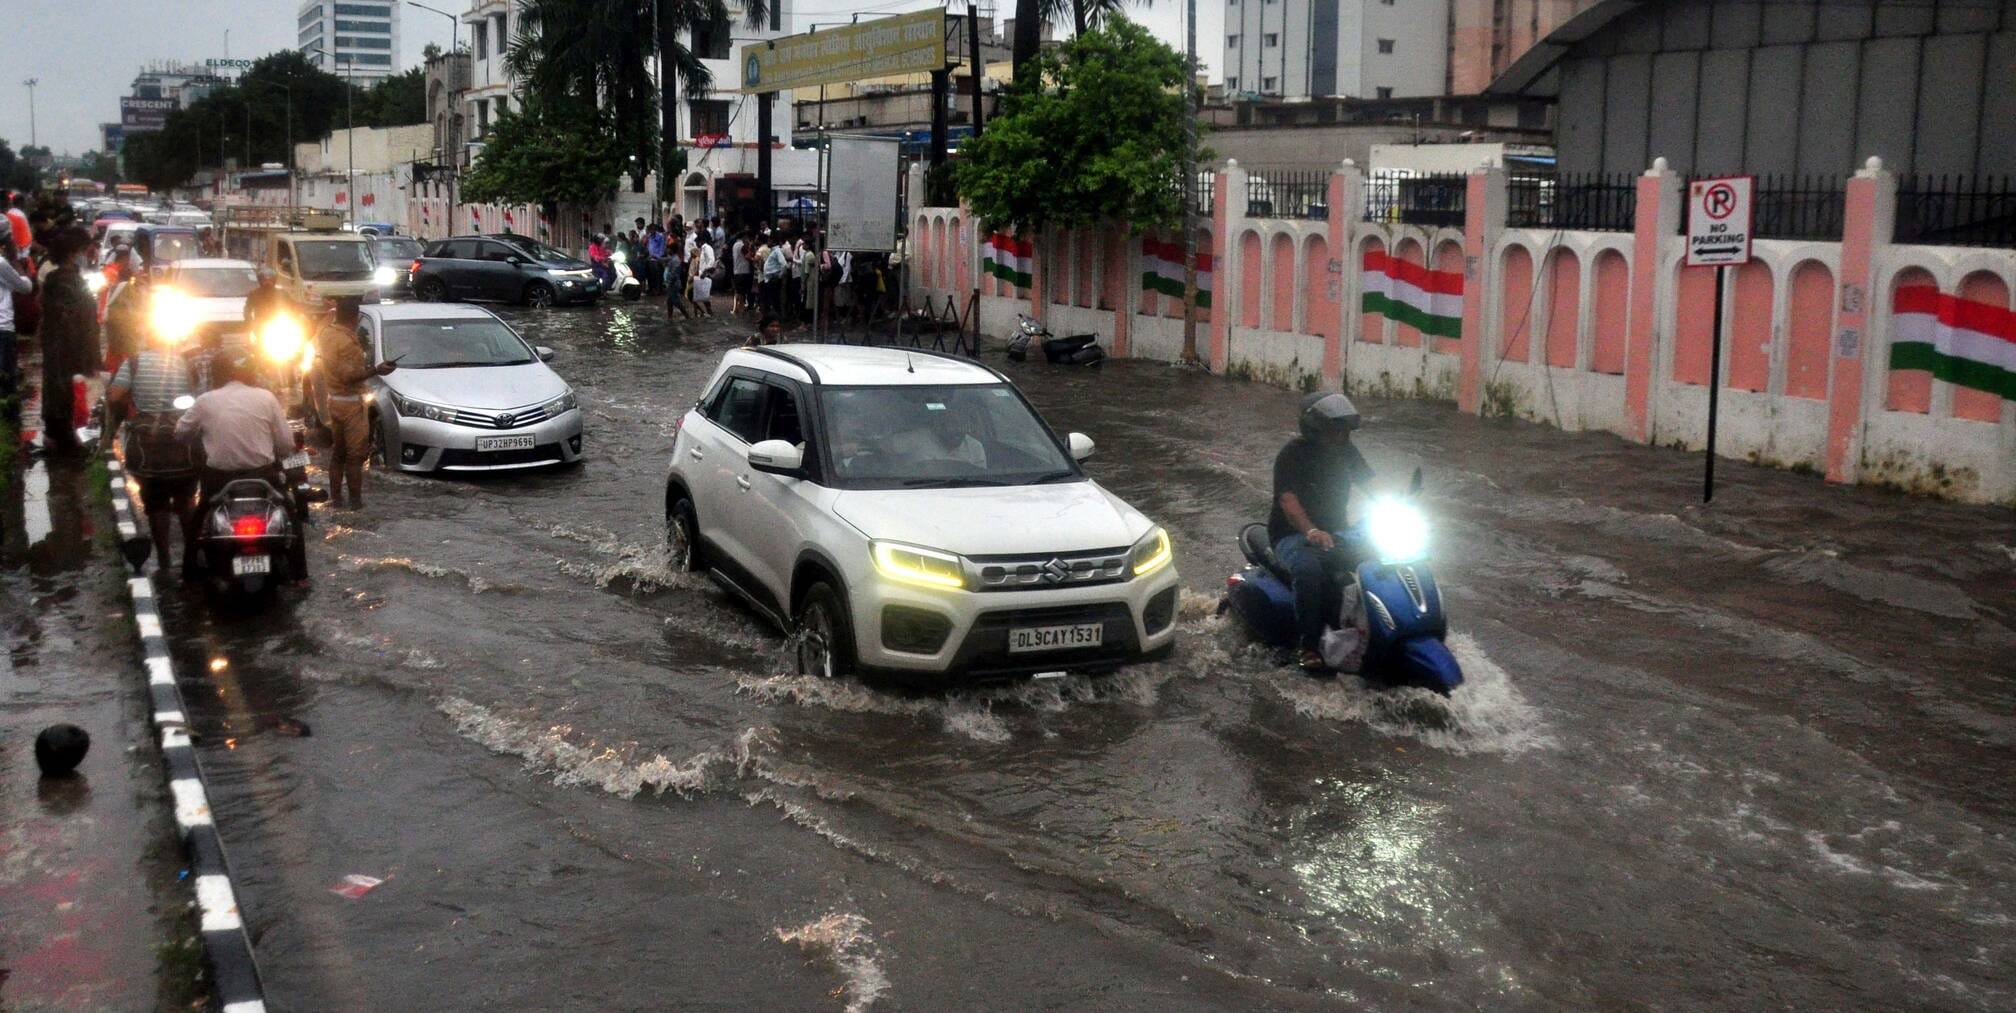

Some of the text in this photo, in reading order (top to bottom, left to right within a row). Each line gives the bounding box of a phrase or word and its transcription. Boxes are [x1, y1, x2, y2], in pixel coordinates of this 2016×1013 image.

[206, 58, 250, 68] ELDECO
[121, 100, 174, 110] CRESCENT
[1710, 223, 1728, 234] NO
[1692, 233, 1745, 245] PARKING
[483, 437, 533, 449] UP32HP9696
[1017, 627, 1101, 648] DL9CAY1531
